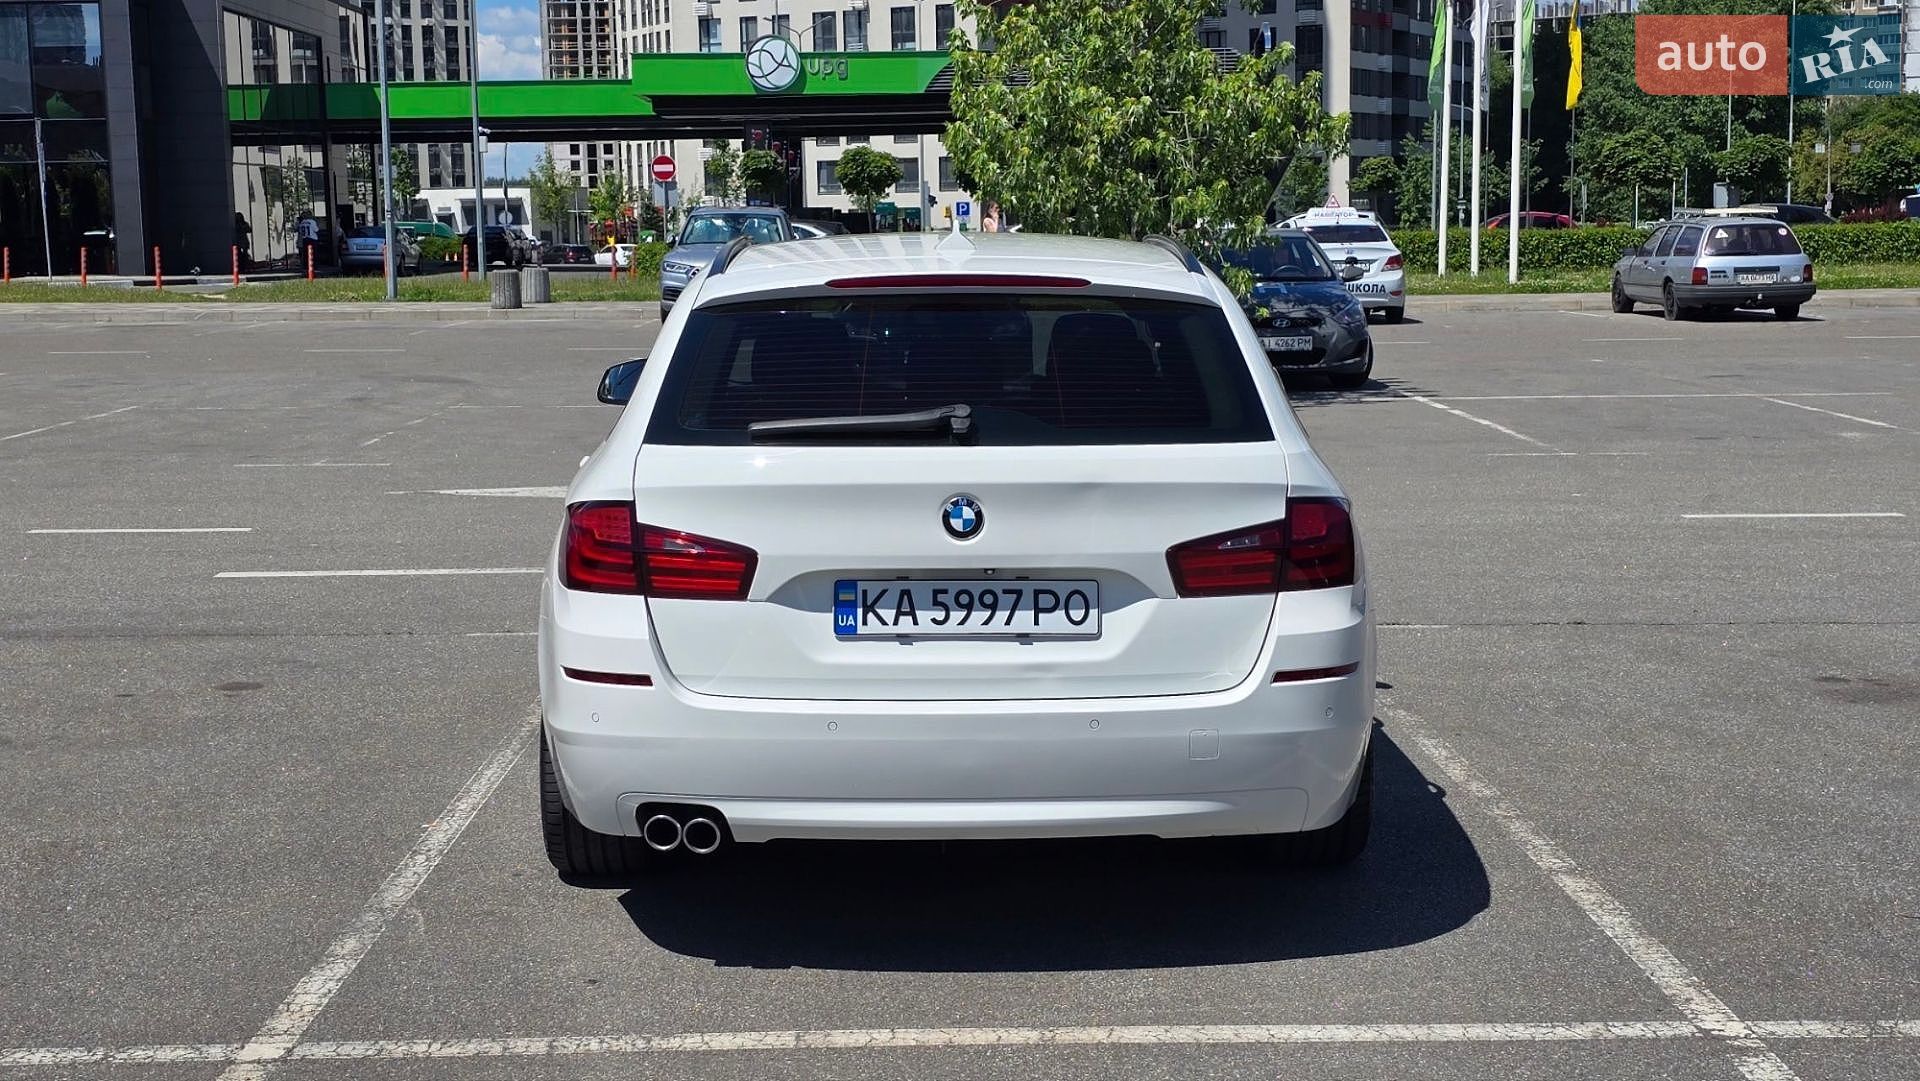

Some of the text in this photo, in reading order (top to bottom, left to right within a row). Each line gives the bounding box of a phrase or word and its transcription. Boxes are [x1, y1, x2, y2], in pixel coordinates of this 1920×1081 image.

[807, 58, 848, 80] upg
[1275, 338, 1296, 348] 4262
[1297, 337, 1311, 347] PM
[946, 498, 981, 513] BMW
[838, 588, 1090, 627] UA KA 5997 PO
